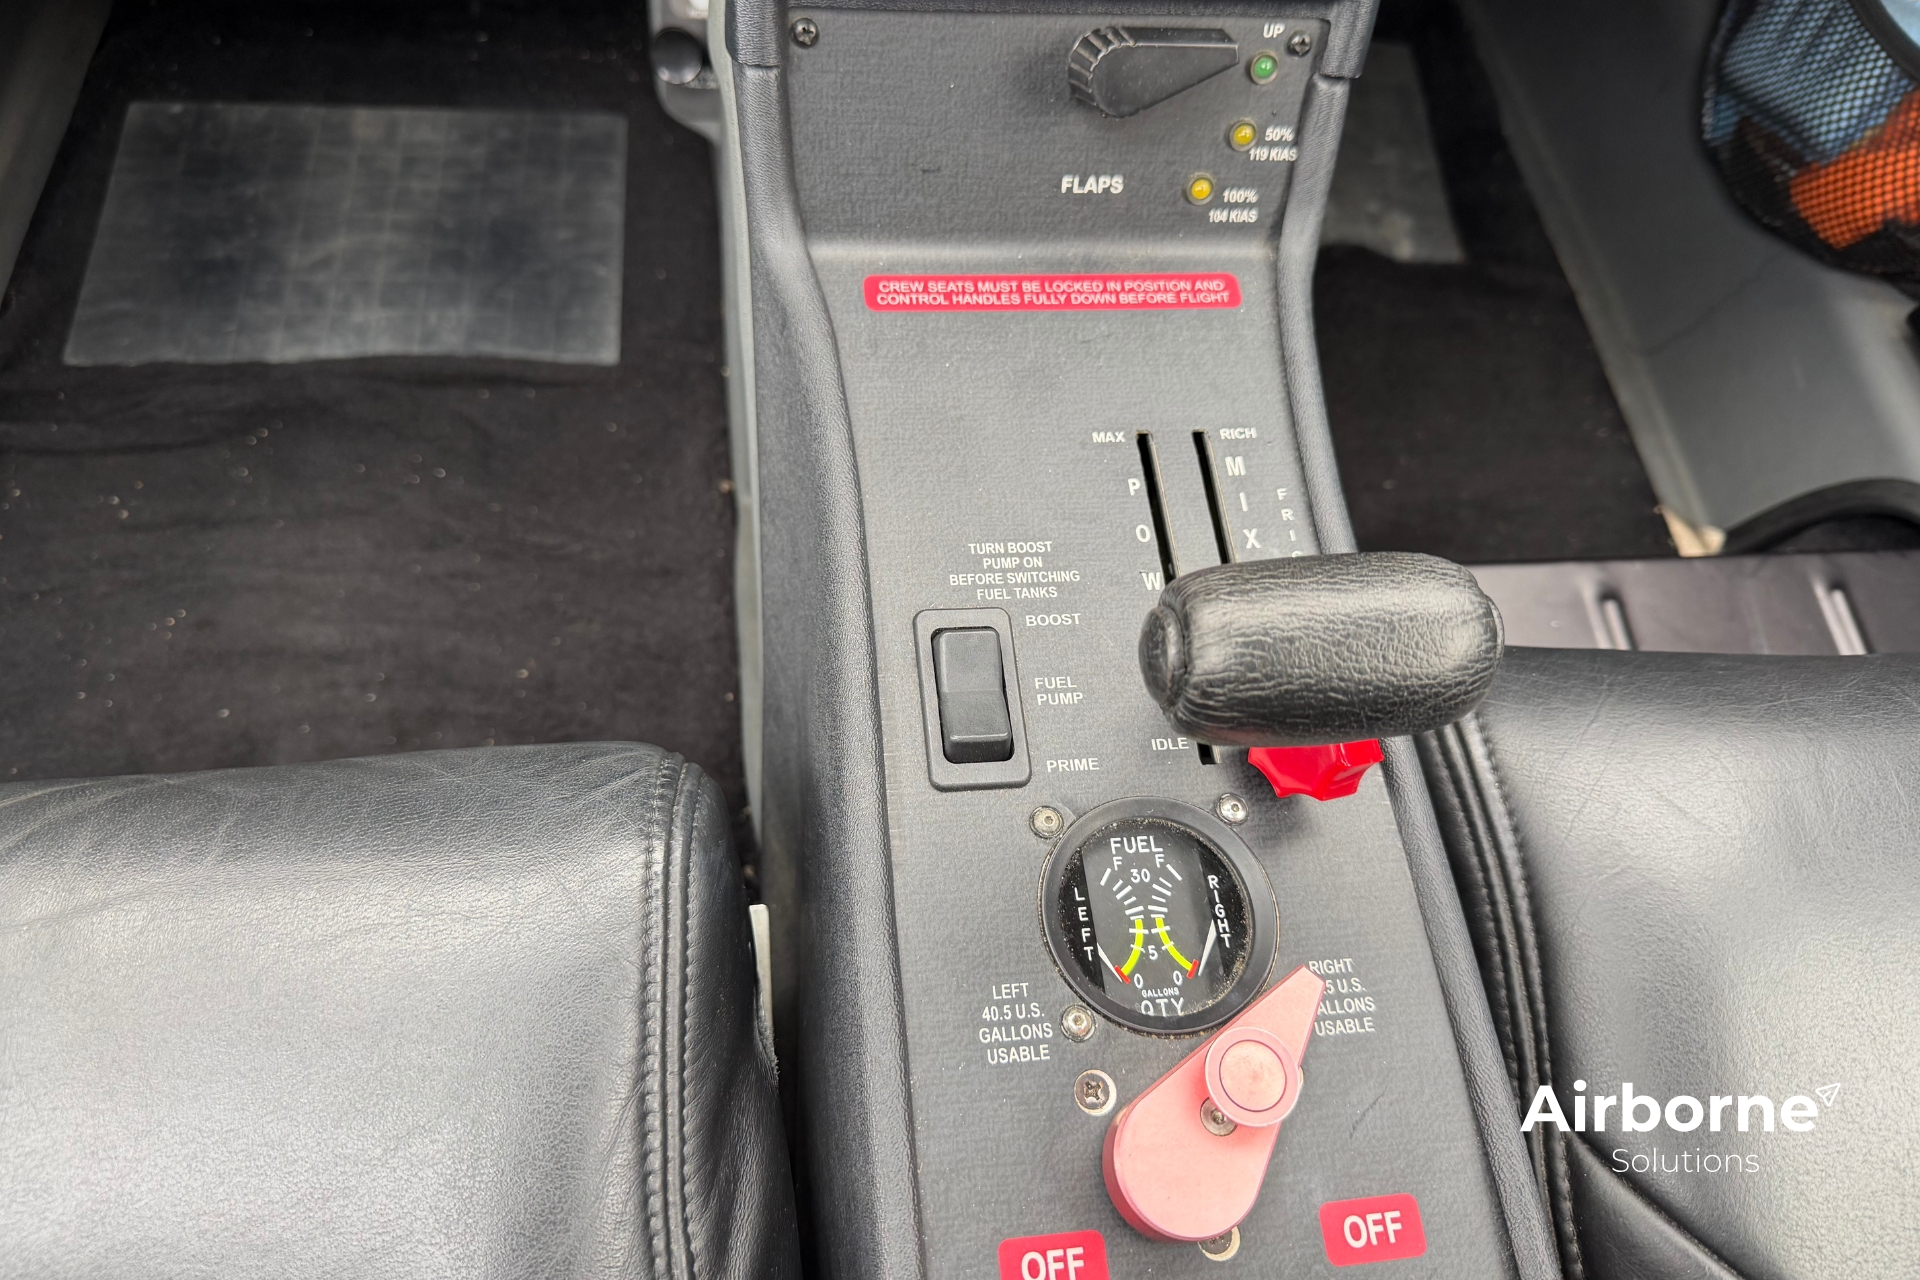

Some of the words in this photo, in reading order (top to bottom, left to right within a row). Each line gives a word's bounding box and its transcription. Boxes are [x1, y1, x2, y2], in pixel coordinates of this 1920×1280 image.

[1263, 23, 1285, 38] UP
[1265, 126, 1293, 141] 50%
[1249, 147, 1268, 161] 119
[1270, 147, 1297, 161] KIAS
[1061, 174, 1124, 193] FLAPS
[1222, 188, 1259, 203] 100%
[1209, 208, 1228, 223] 104
[1229, 207, 1259, 222] KIAS
[879, 280, 924, 293] CREW
[928, 280, 974, 293] SEATS
[977, 280, 1018, 293] MUST
[1022, 280, 1041, 293] BE
[1045, 279, 1102, 292] LOCKED
[1106, 279, 1121, 292] IN
[1124, 279, 1191, 292] POSITION
[1195, 279, 1225, 291] AND
[877, 293, 949, 305] CONTROL
[952, 293, 1021, 305] HANDLES
[1024, 293, 1067, 305] FULLY
[1071, 293, 1116, 305] DOWN
[1119, 292, 1177, 304] BEFORE
[1180, 291, 1229, 303] FLIGHT
[1092, 431, 1126, 443] MAX
[1219, 427, 1258, 440] RICH
[968, 543, 1005, 554] TURN
[1007, 541, 1052, 553] BOOST
[983, 558, 1020, 569] PUMP
[1023, 557, 1043, 568] ON
[949, 573, 1005, 586] BEFORE
[1006, 570, 1081, 584] SWITCHING
[976, 588, 1012, 600] FUEL
[1013, 586, 1058, 599] TANKS
[1025, 613, 1081, 627] BOOST
[1034, 677, 1077, 689] FUEL
[1036, 692, 1083, 706] PUMP
[1151, 737, 1189, 750] IDLE
[1046, 757, 1100, 772] PRIME
[1110, 836, 1164, 854] FUEL
[1113, 856, 1123, 871] F
[1155, 853, 1165, 868] F
[1130, 868, 1150, 884] 30
[1207, 874, 1232, 949] RIGHT
[1074, 886, 1095, 962] LEFT
[1149, 945, 1159, 961] 5
[1308, 957, 1353, 975] RIGHT
[992, 982, 1028, 1000] LEFT
[1141, 987, 1180, 998] GALLONS
[1336, 977, 1367, 993] U.S.
[981, 1004, 1012, 1021] 40.5
[1015, 1002, 1045, 1019] U.S.
[1317, 996, 1376, 1016] ALLONS
[978, 1022, 1053, 1044] GALLONS
[1314, 1016, 1376, 1036] USABLE
[987, 1044, 1050, 1065] USABLE
[1343, 1210, 1402, 1249] OFF
[1020, 1246, 1085, 1280] OFF
